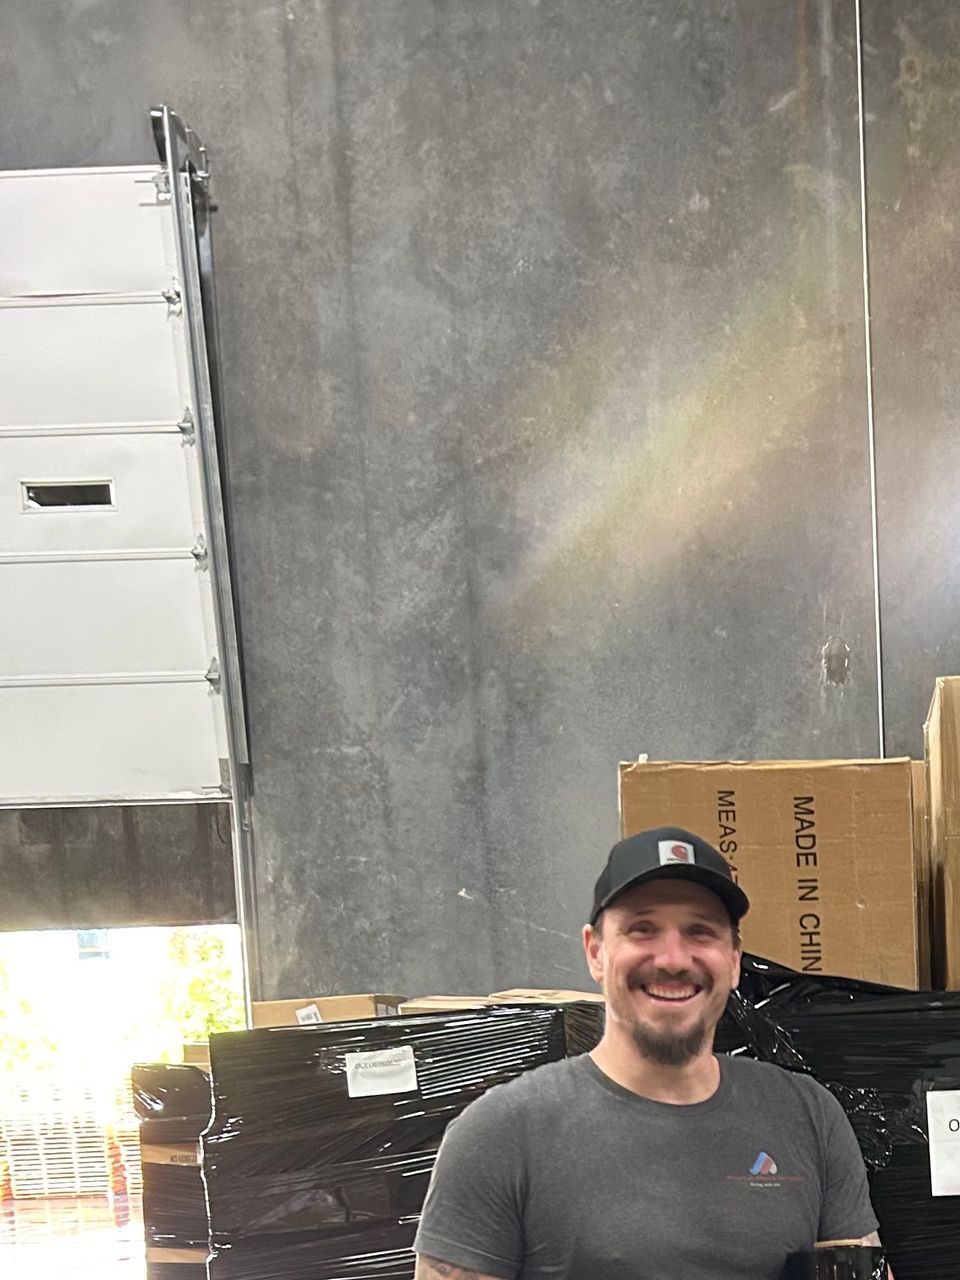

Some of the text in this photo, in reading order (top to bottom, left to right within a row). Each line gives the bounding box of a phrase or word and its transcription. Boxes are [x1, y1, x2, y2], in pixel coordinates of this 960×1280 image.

[793, 796, 823, 972] MADE IN CHIN
